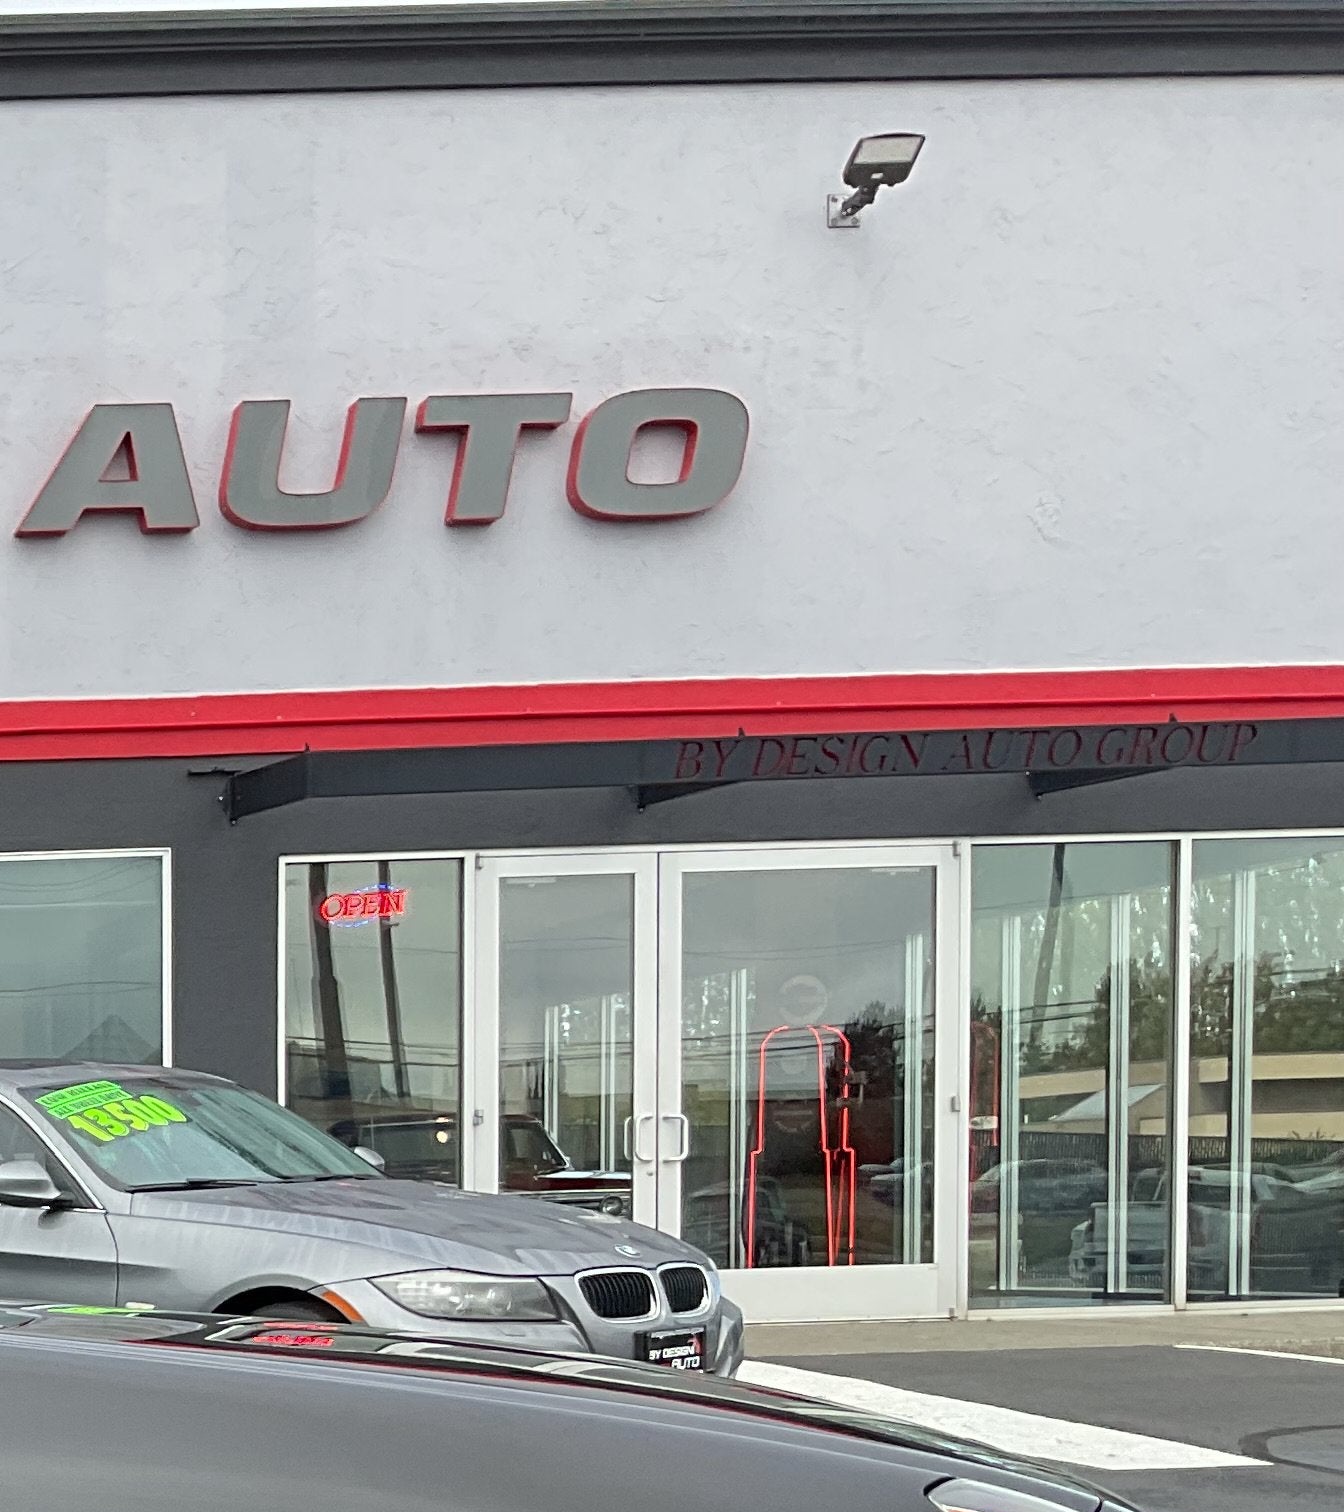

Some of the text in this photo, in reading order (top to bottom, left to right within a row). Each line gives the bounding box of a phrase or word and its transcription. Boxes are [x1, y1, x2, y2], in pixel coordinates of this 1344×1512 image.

[14, 387, 751, 540] AUTO
[672, 722, 1259, 780] BY DESIGN AUTO GROUP
[320, 889, 409, 922] OPEN
[68, 1095, 187, 1142] 13500
[672, 1356, 700, 1369] AUTO
